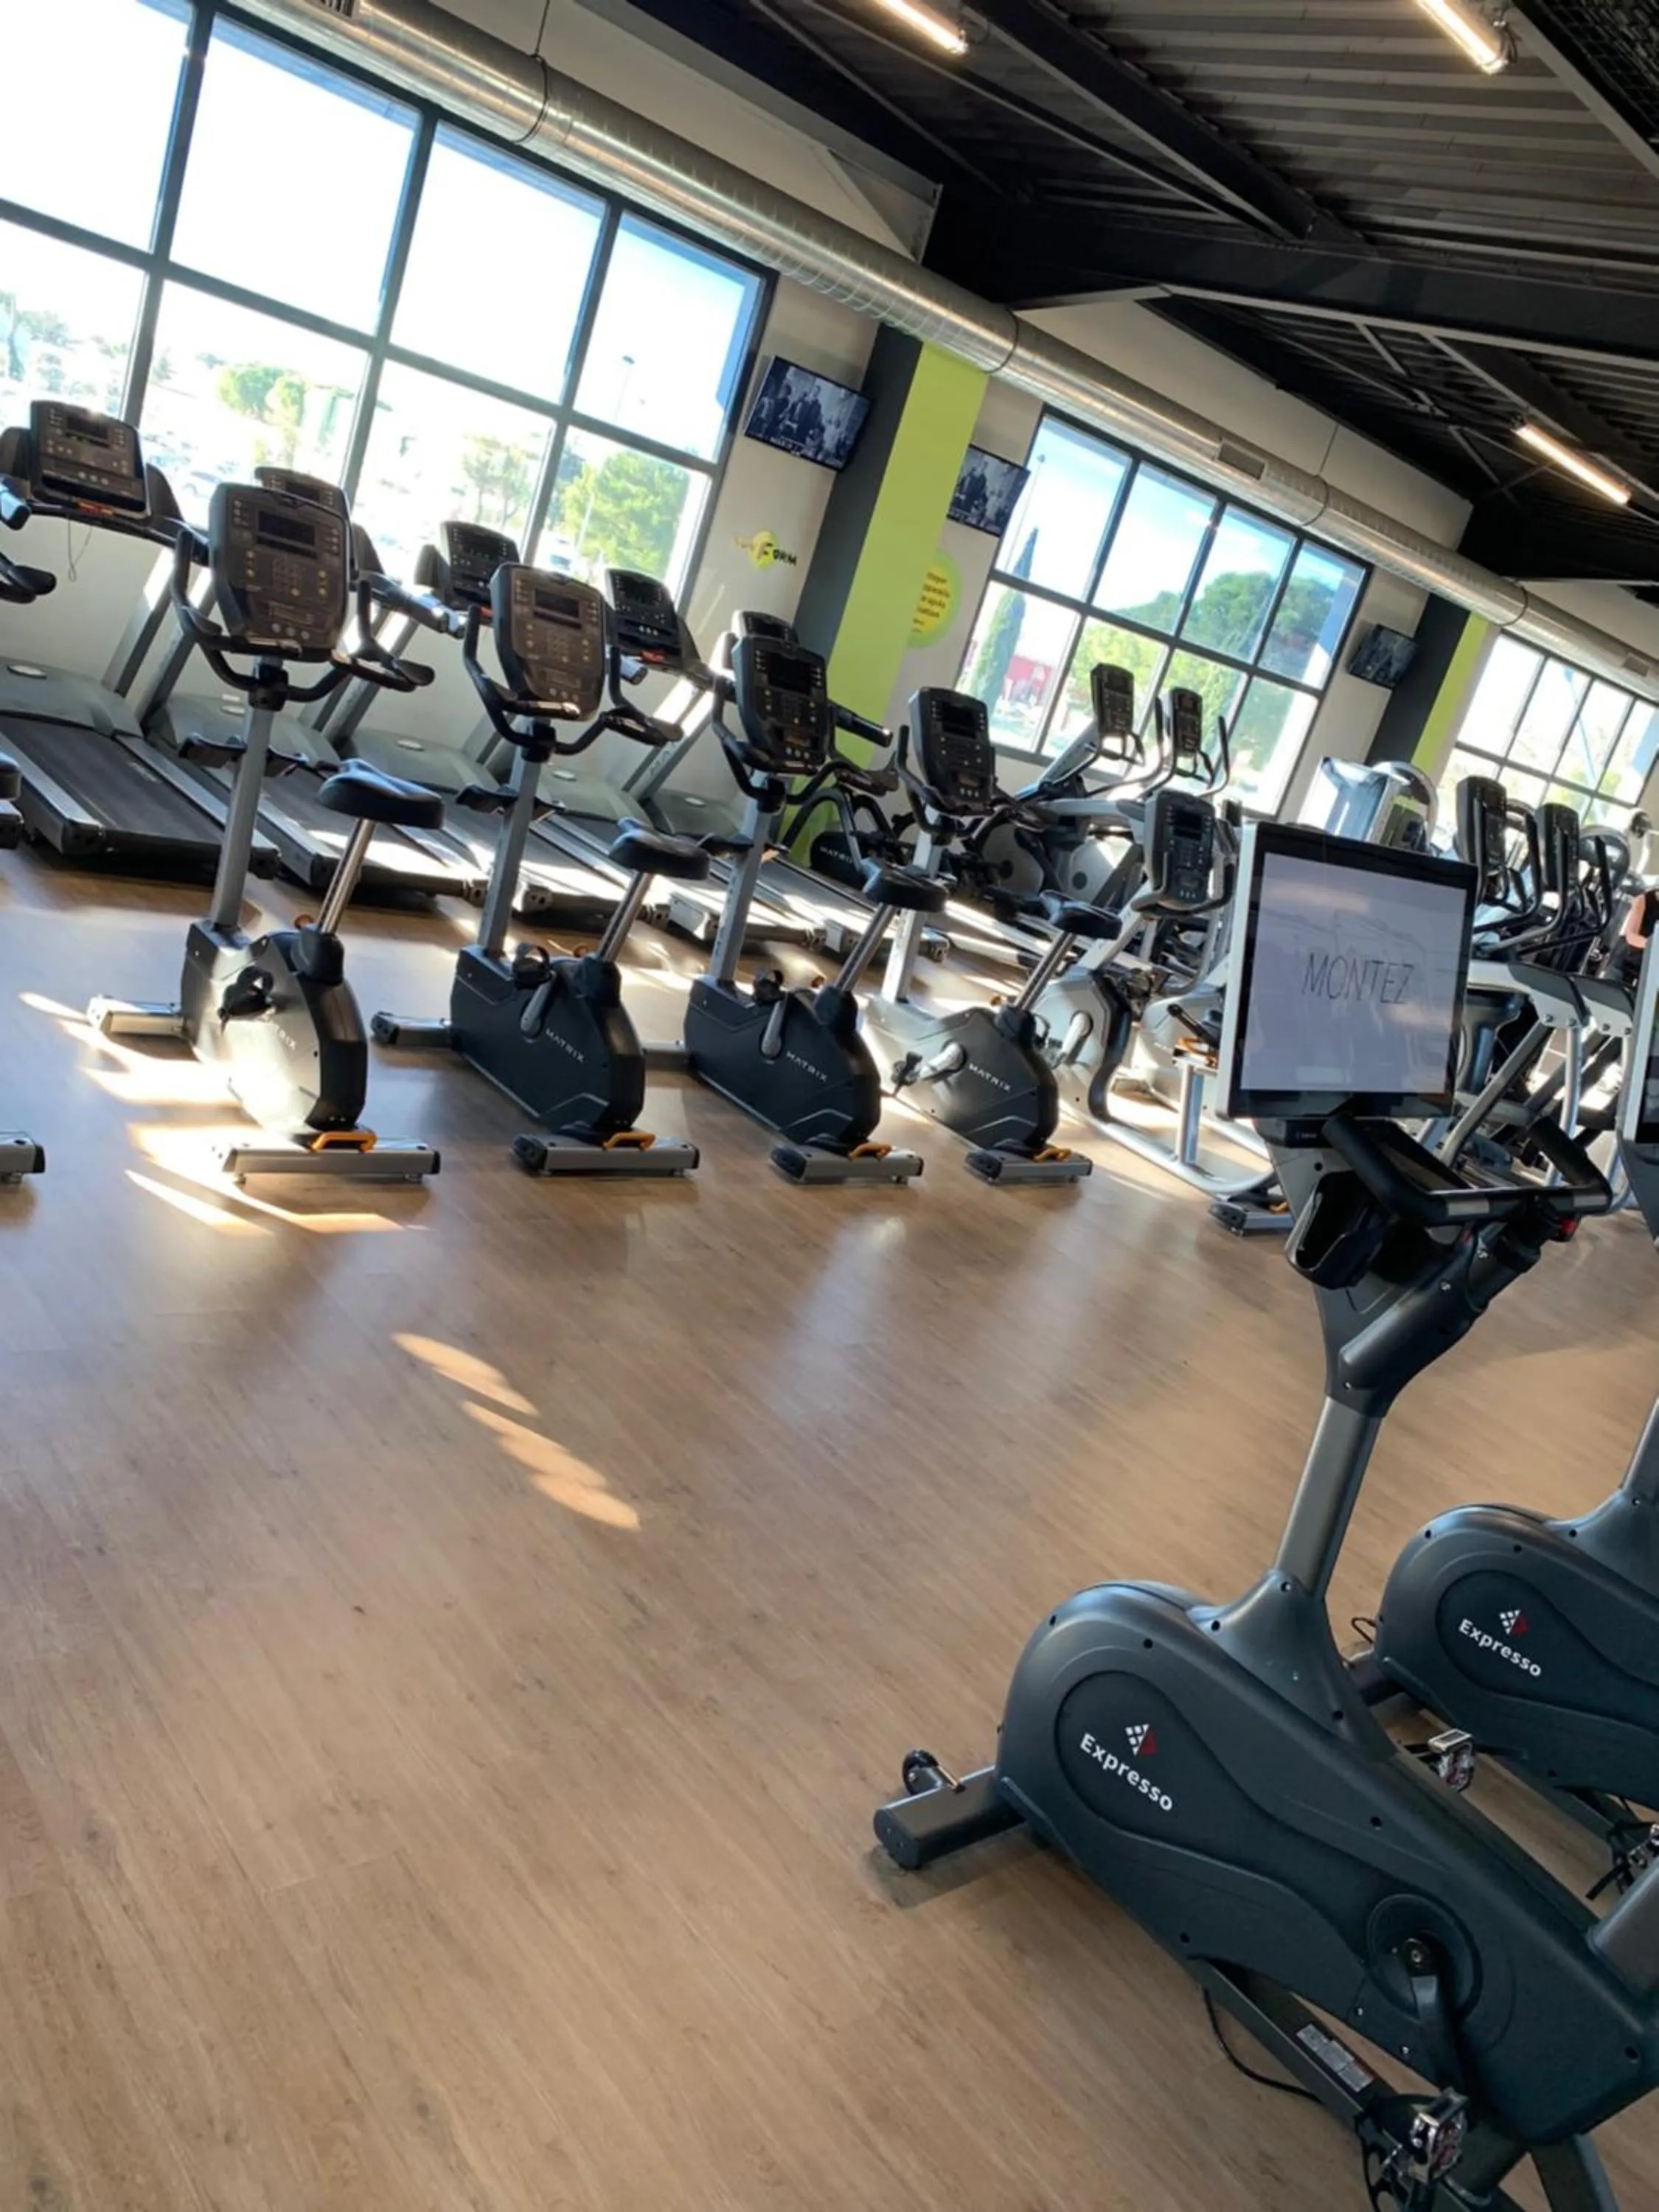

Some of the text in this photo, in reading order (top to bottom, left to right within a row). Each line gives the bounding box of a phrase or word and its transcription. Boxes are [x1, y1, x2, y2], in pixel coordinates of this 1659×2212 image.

[1301, 951, 1414, 1004] MONTEZ
[545, 1027, 585, 1062] MATRIX
[786, 1050, 827, 1083] MATRIX
[968, 1062, 1011, 1092] MATRIX
[1458, 1618, 1541, 1677] Expresso
[1079, 1733, 1173, 1812] Expresso
